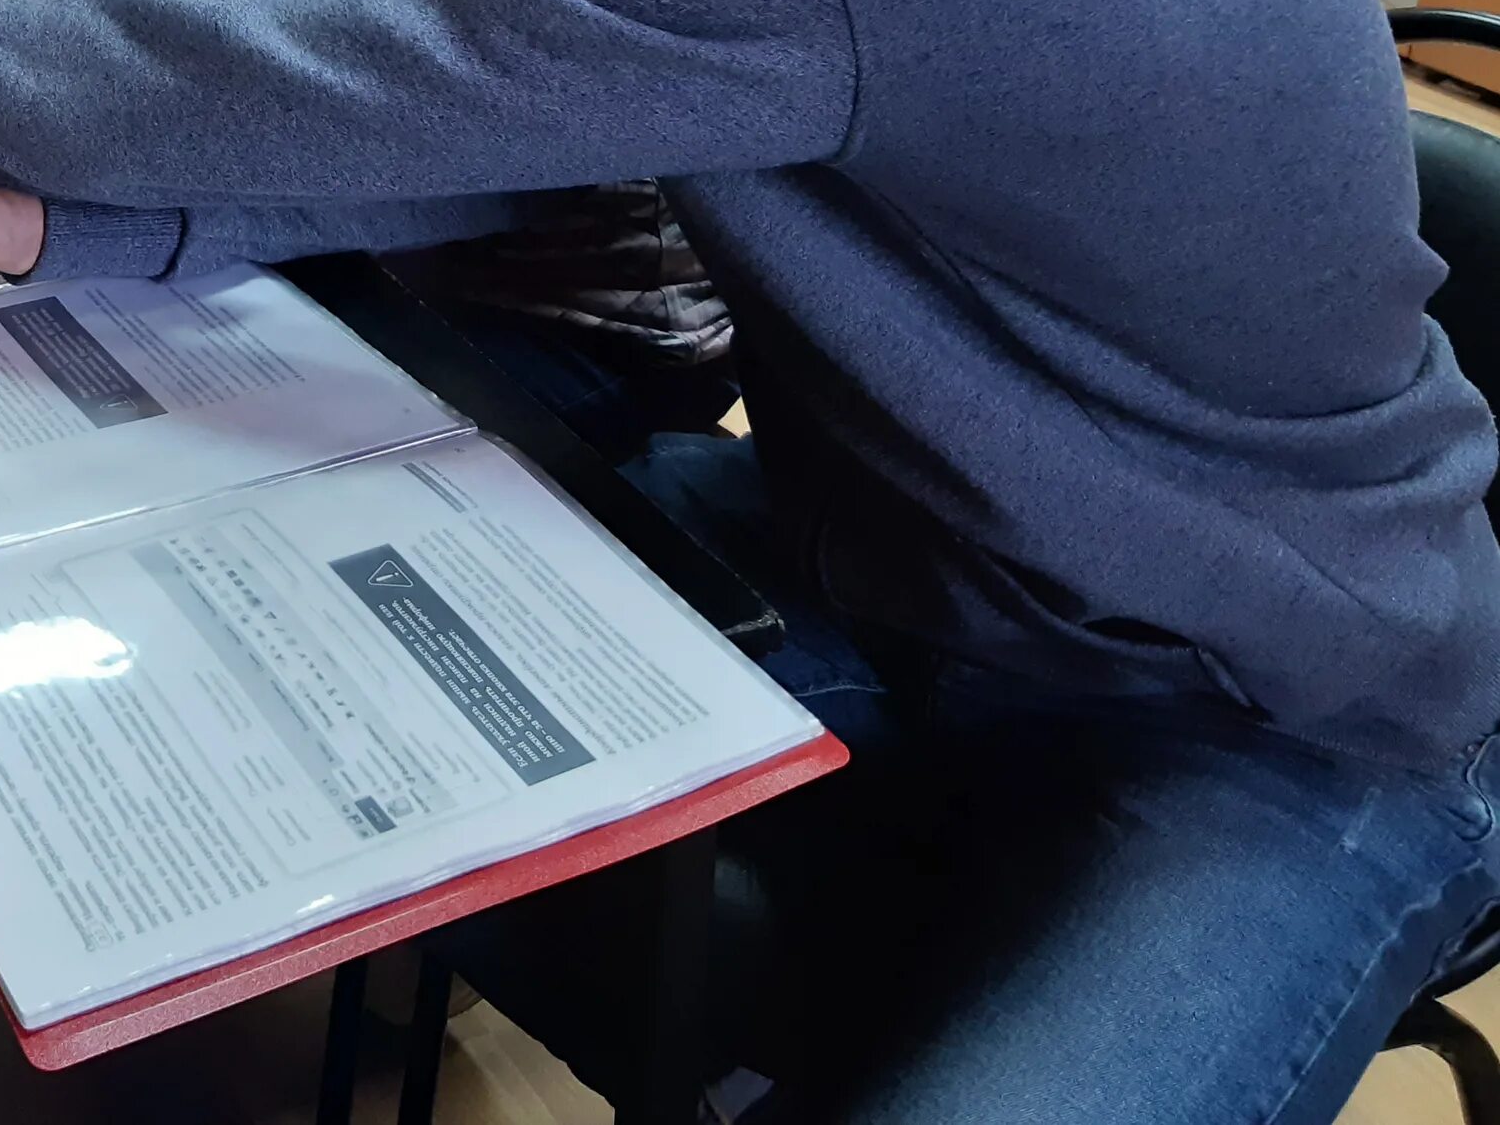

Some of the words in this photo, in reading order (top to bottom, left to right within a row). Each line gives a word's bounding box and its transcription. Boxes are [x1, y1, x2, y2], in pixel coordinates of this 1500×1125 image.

[391, 619, 408, 635] той
[413, 642, 448, 678] подвести
[435, 633, 484, 684] поясняющую
[440, 655, 469, 684] панели
[445, 678, 472, 705] мыши
[478, 663, 508, 693] кнопка
[469, 687, 483, 699] на
[504, 691, 521, 706] эта
[483, 702, 517, 737] надписи
[485, 686, 525, 728] прочитать
[517, 705, 532, 721] что
[471, 705, 511, 746] указатель
[531, 719, 543, 731] за
[507, 746, 529, 768] Если
[516, 740, 541, 763] иной
[524, 730, 554, 758] можно
